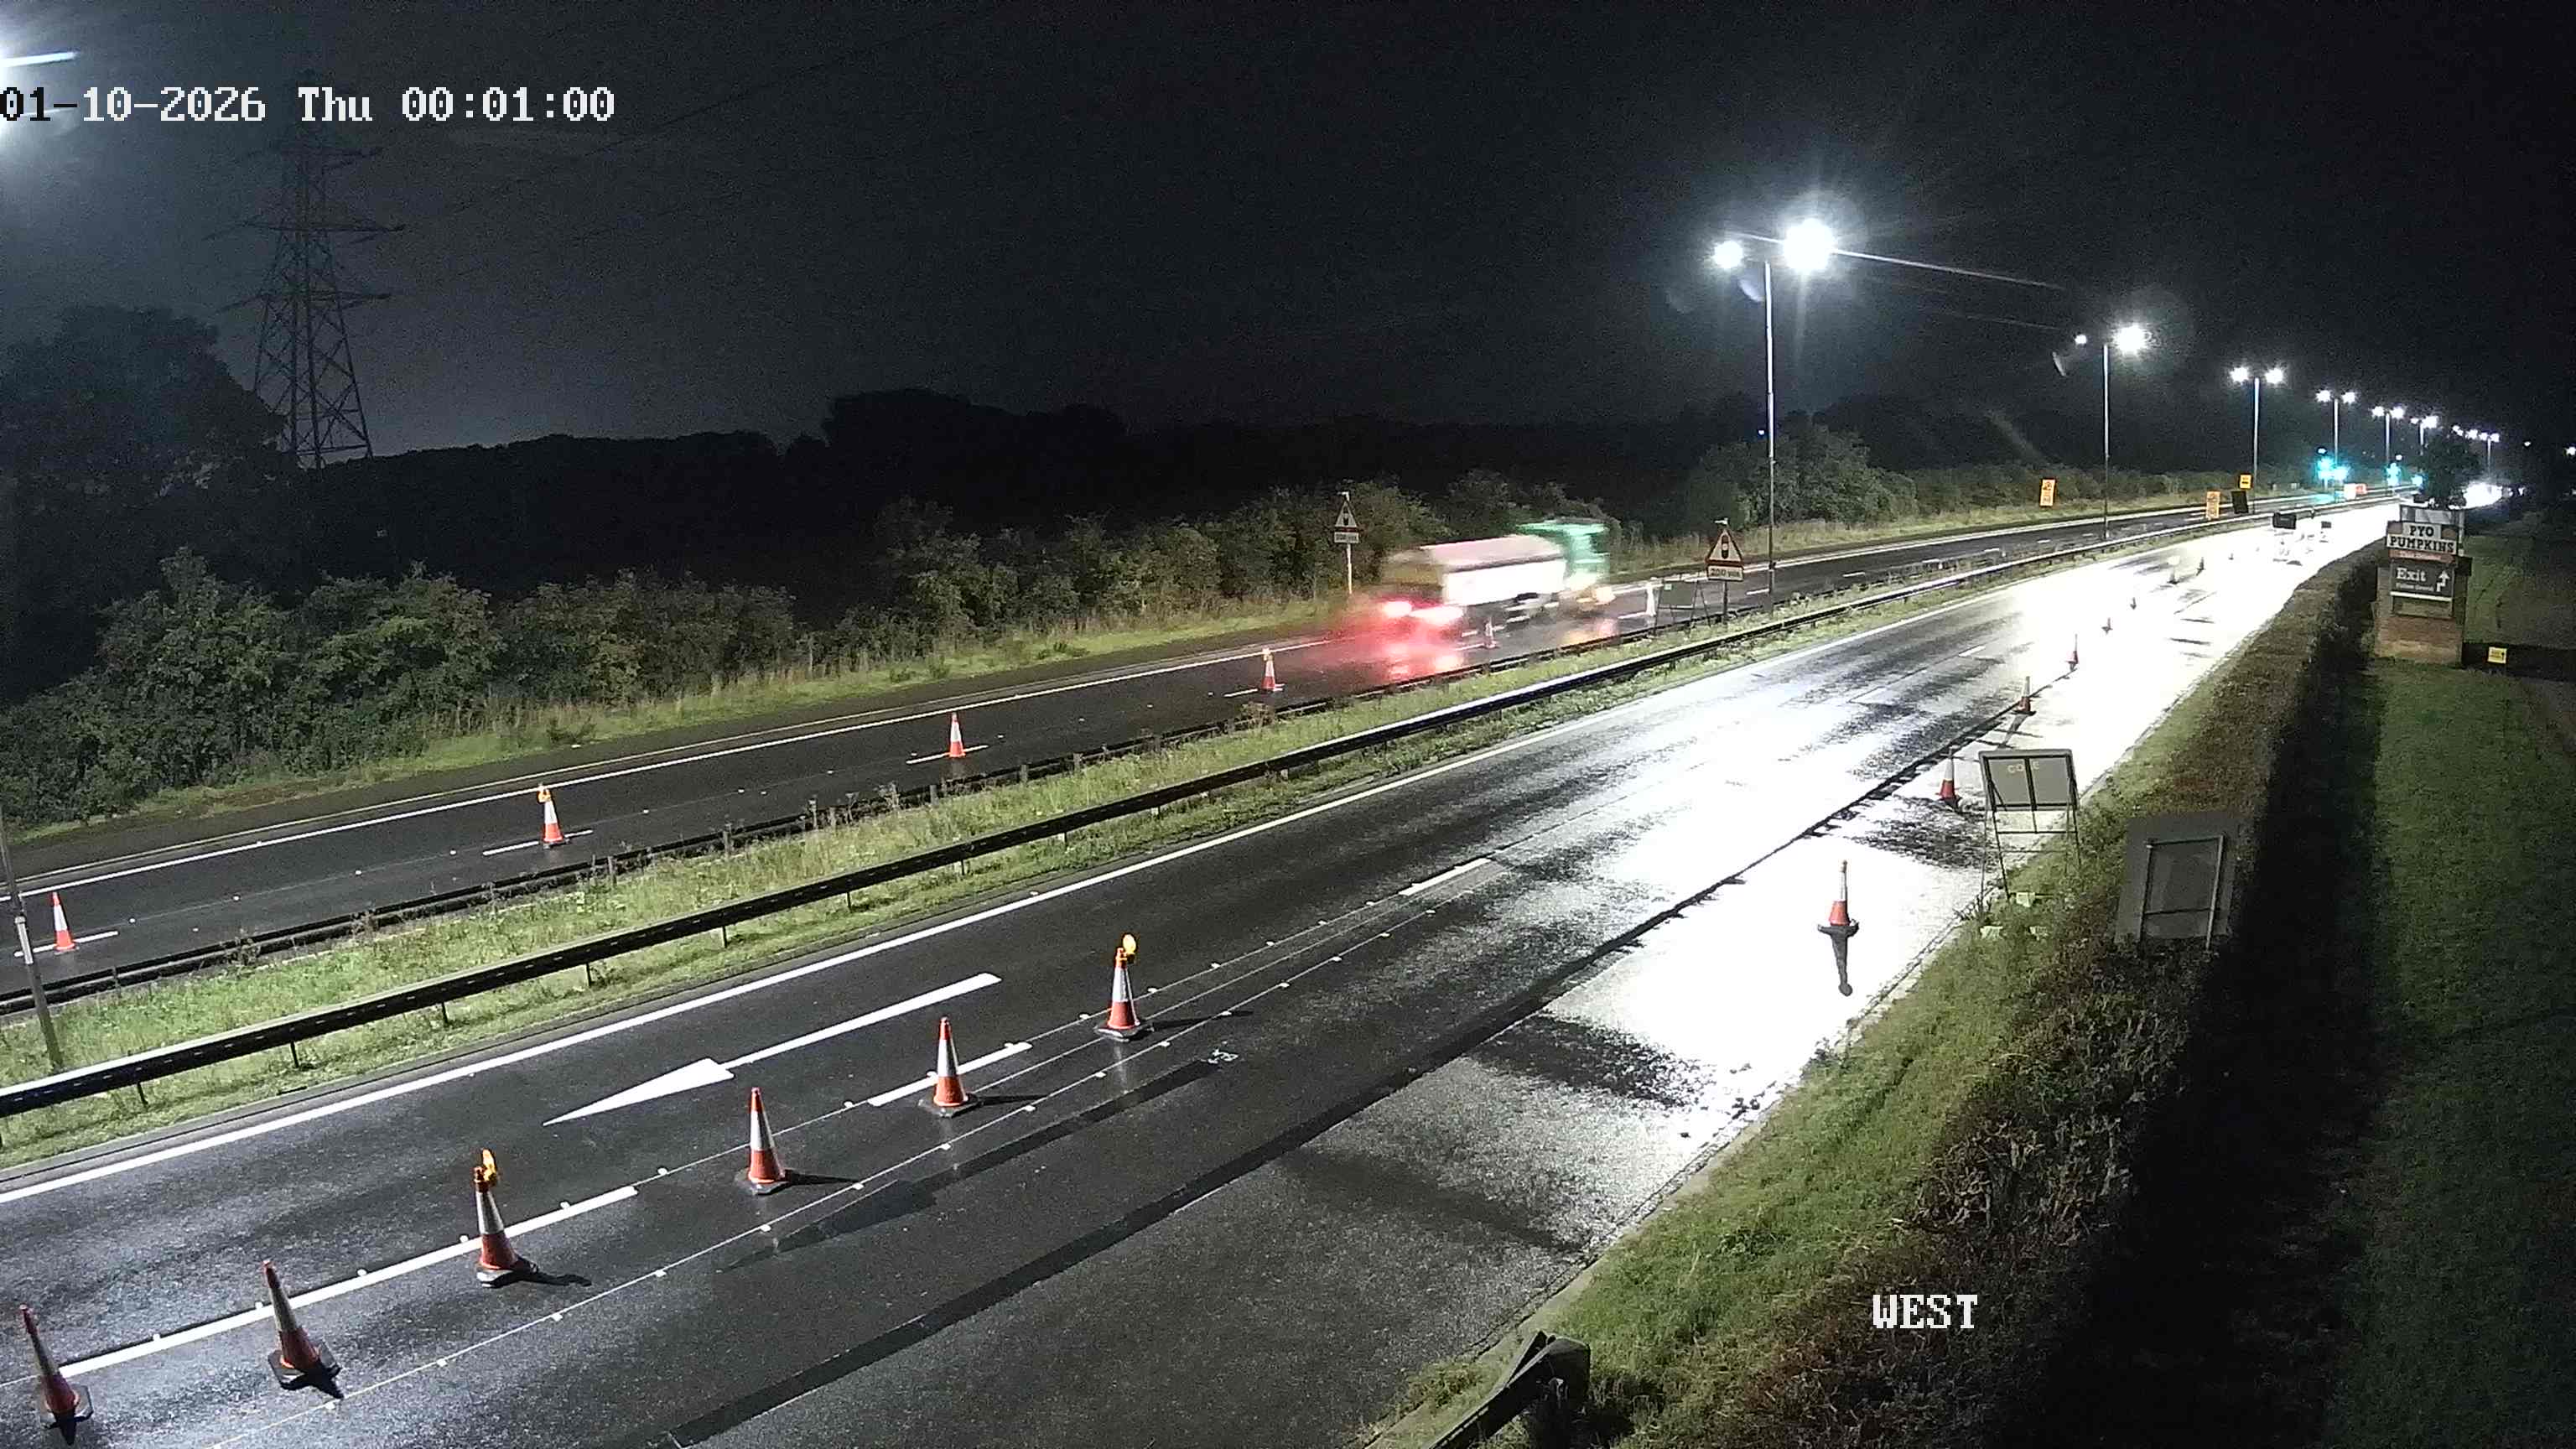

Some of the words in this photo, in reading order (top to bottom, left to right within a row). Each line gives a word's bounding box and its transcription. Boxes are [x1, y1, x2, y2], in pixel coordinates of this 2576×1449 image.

[2409, 526, 2434, 537] PYO
[2389, 536, 2454, 553] PUMPKINS
[2397, 567, 2426, 582] Exit
[2007, 761, 2040, 774] COE
